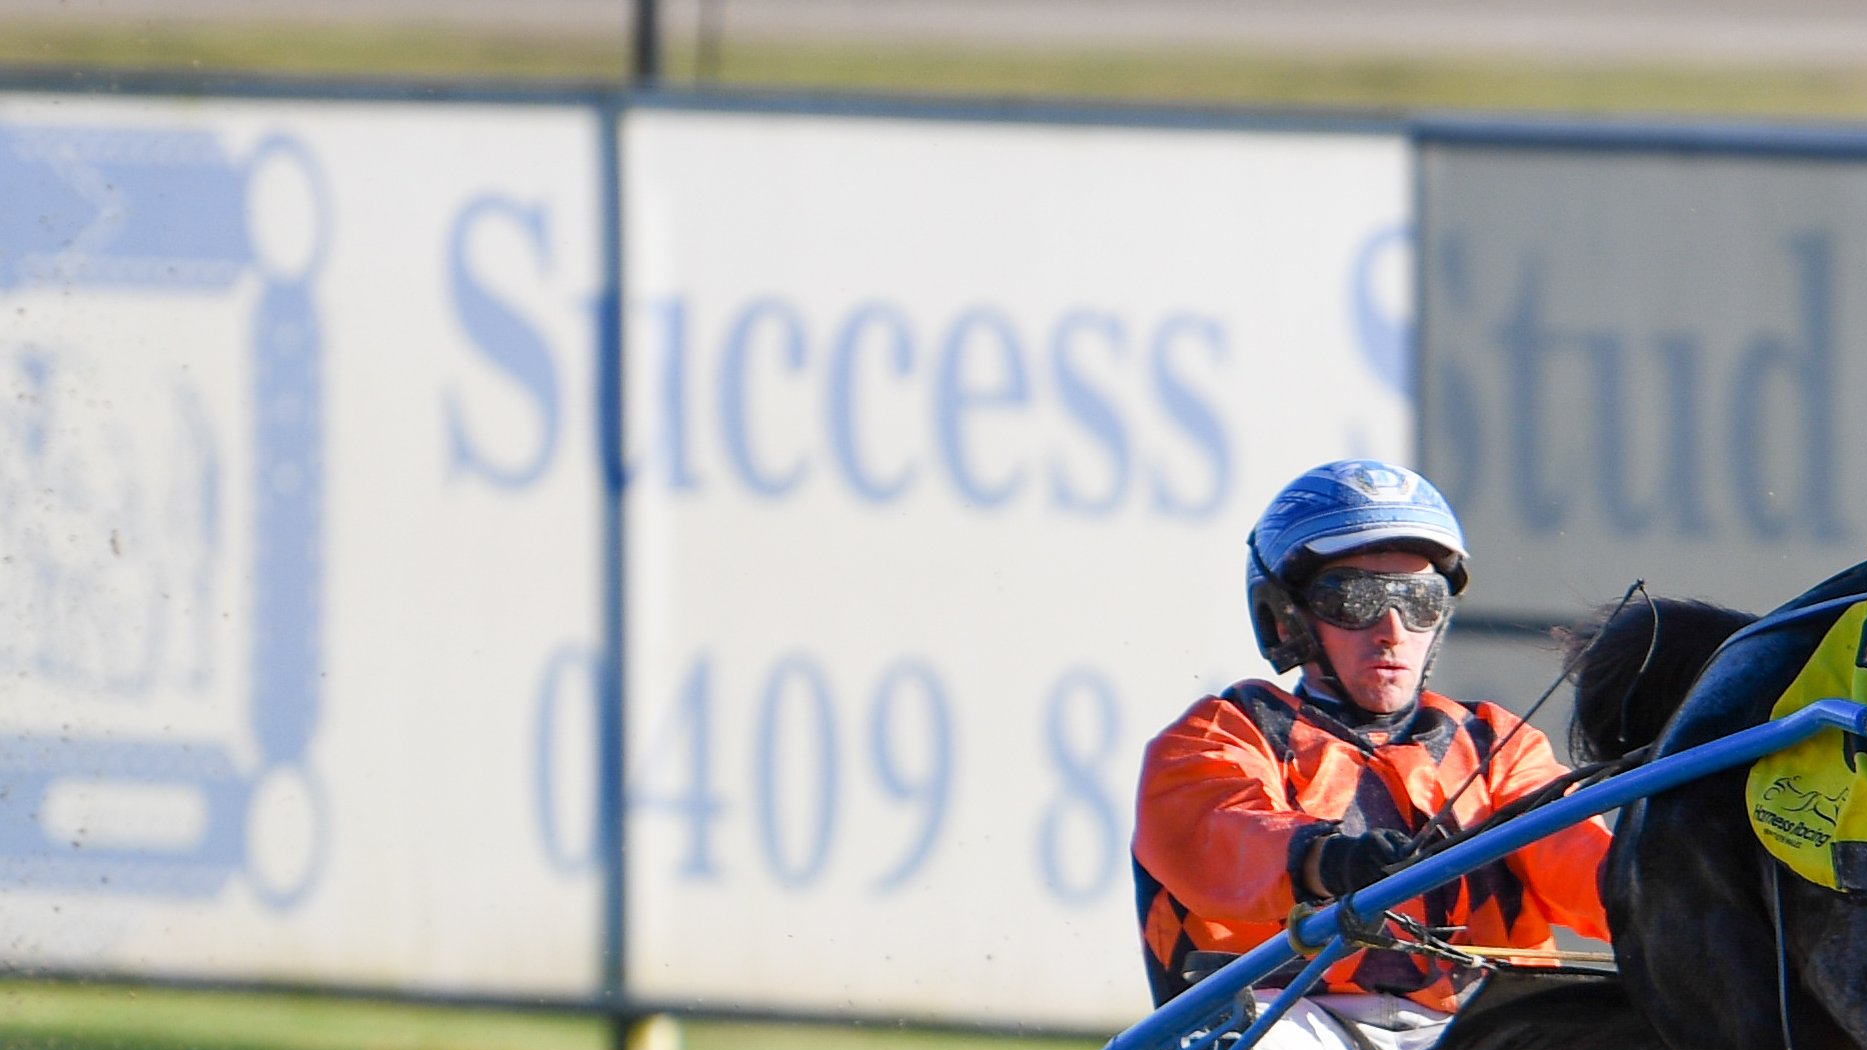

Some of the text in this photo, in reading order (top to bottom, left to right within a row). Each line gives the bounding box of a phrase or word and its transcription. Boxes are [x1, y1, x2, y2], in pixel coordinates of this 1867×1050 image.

[441, 192, 1856, 545] Success Stud
[534, 640, 956, 899] 0409
